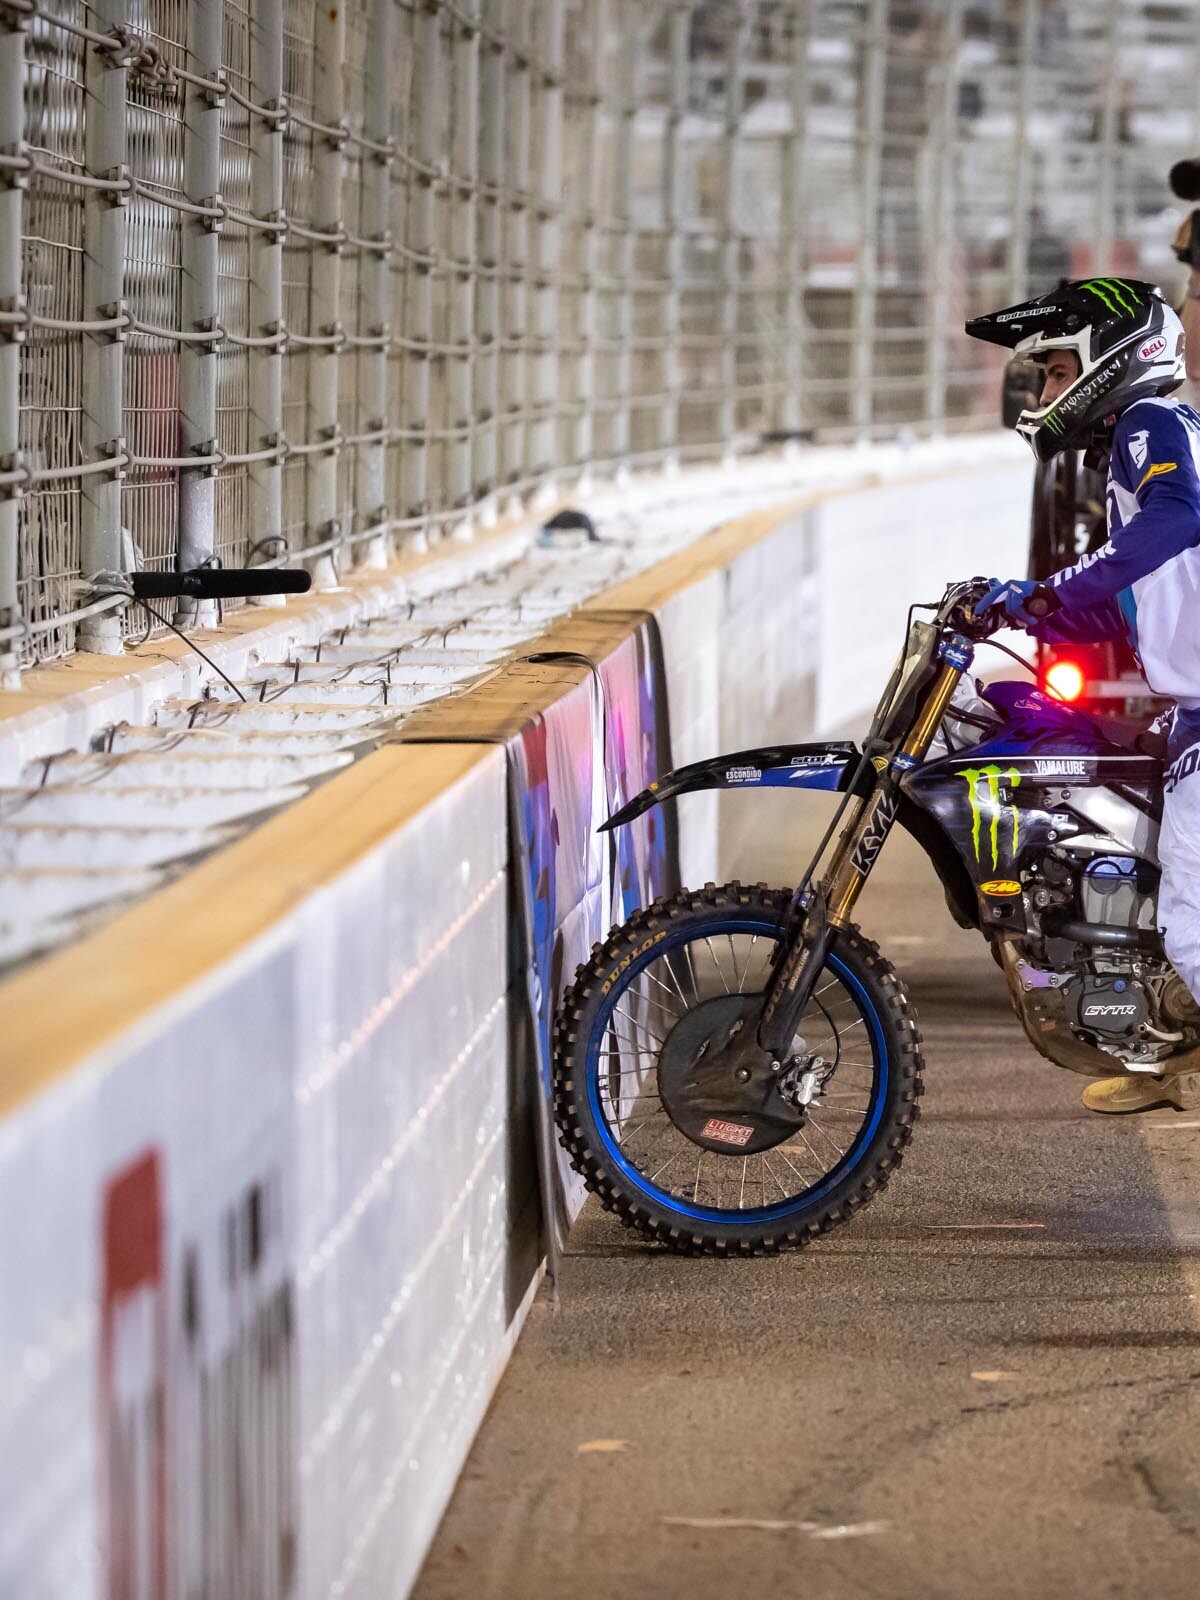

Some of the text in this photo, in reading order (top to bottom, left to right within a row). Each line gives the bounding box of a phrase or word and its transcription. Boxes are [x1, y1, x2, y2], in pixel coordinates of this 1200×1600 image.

[1141, 340, 1164, 358] BELL
[1059, 369, 1114, 414] MONSTER
[725, 769, 762, 779] ESCONDIDO
[1034, 760, 1087, 775] YAMALUBE
[602, 931, 667, 997] DUNLOP
[1084, 1005, 1137, 1016] GYTR
[708, 1119, 753, 1136] LIGHT
[702, 1128, 747, 1146] SPEED
